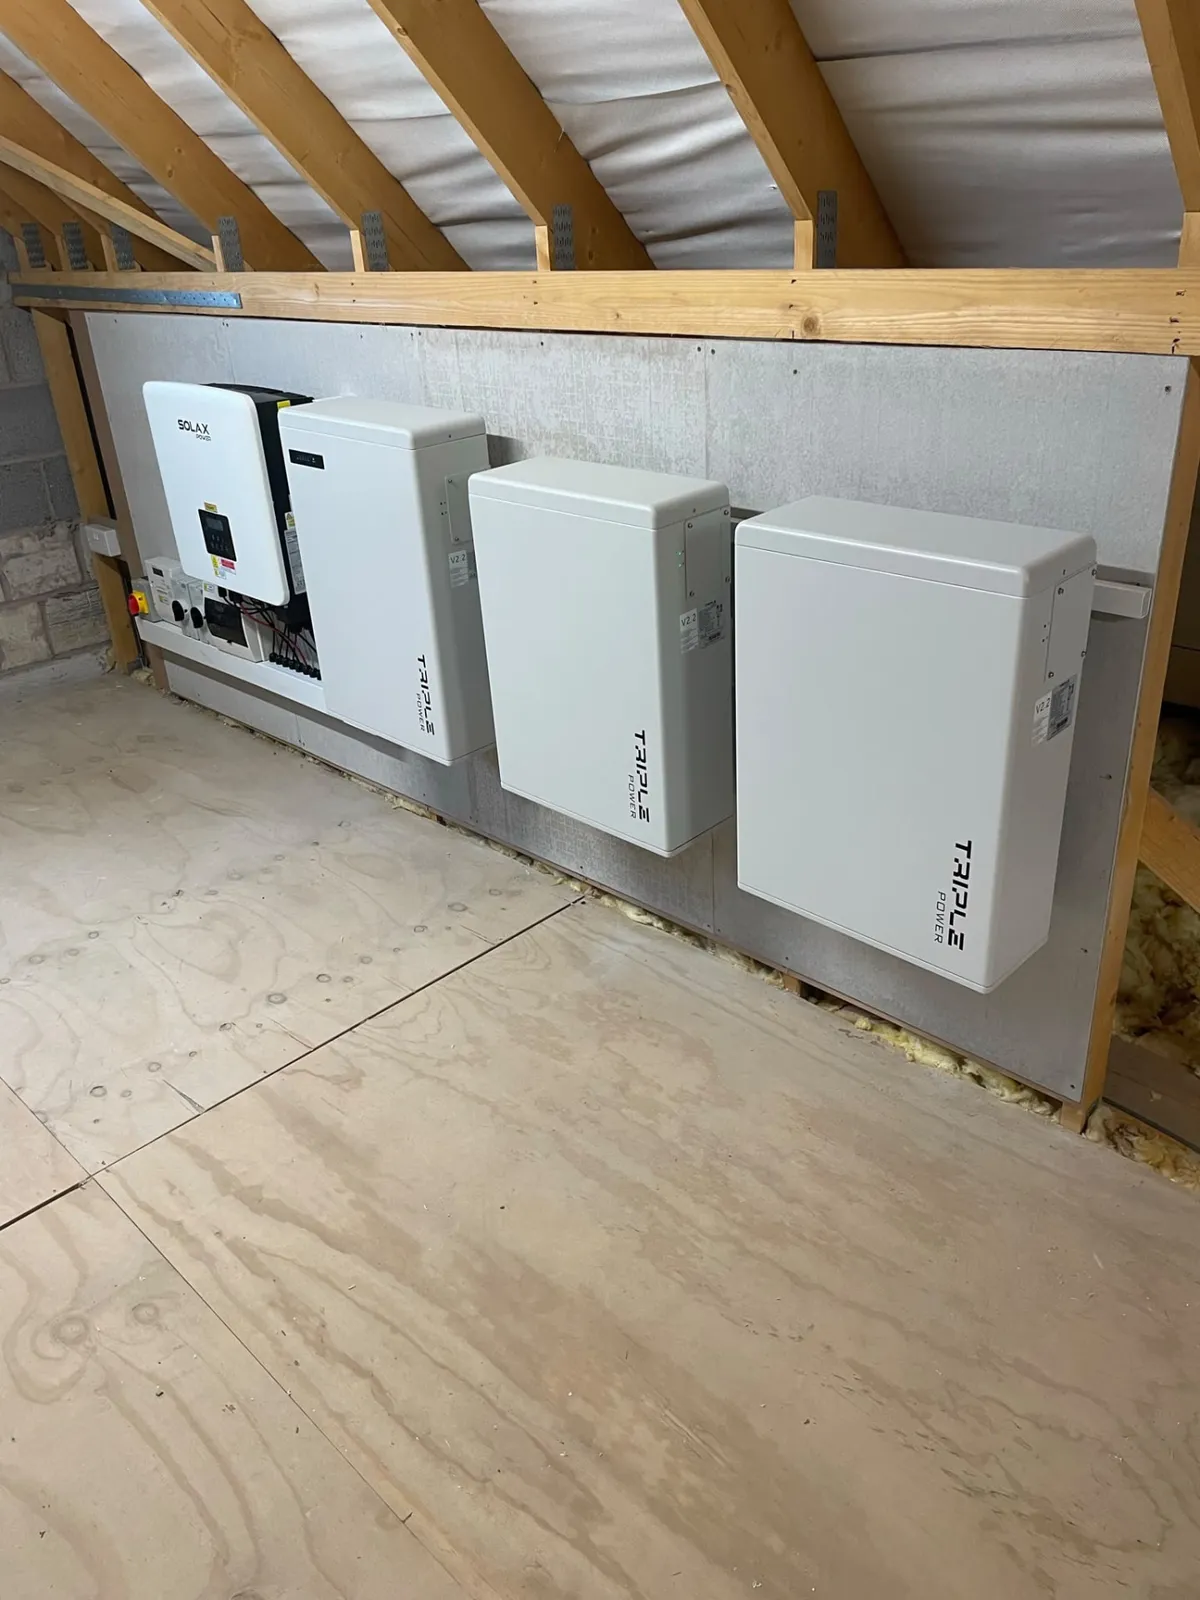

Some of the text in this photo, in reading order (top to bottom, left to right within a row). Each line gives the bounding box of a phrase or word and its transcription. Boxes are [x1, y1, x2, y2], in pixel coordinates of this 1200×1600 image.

[178, 419, 210, 435] SOLAX
[416, 693, 425, 731] POWER
[417, 654, 435, 736] TRIPLE
[628, 774, 637, 819] POWER
[634, 729, 650, 823] TRIPLE
[934, 890, 946, 944] POWER
[948, 840, 972, 951] TRIPLE
